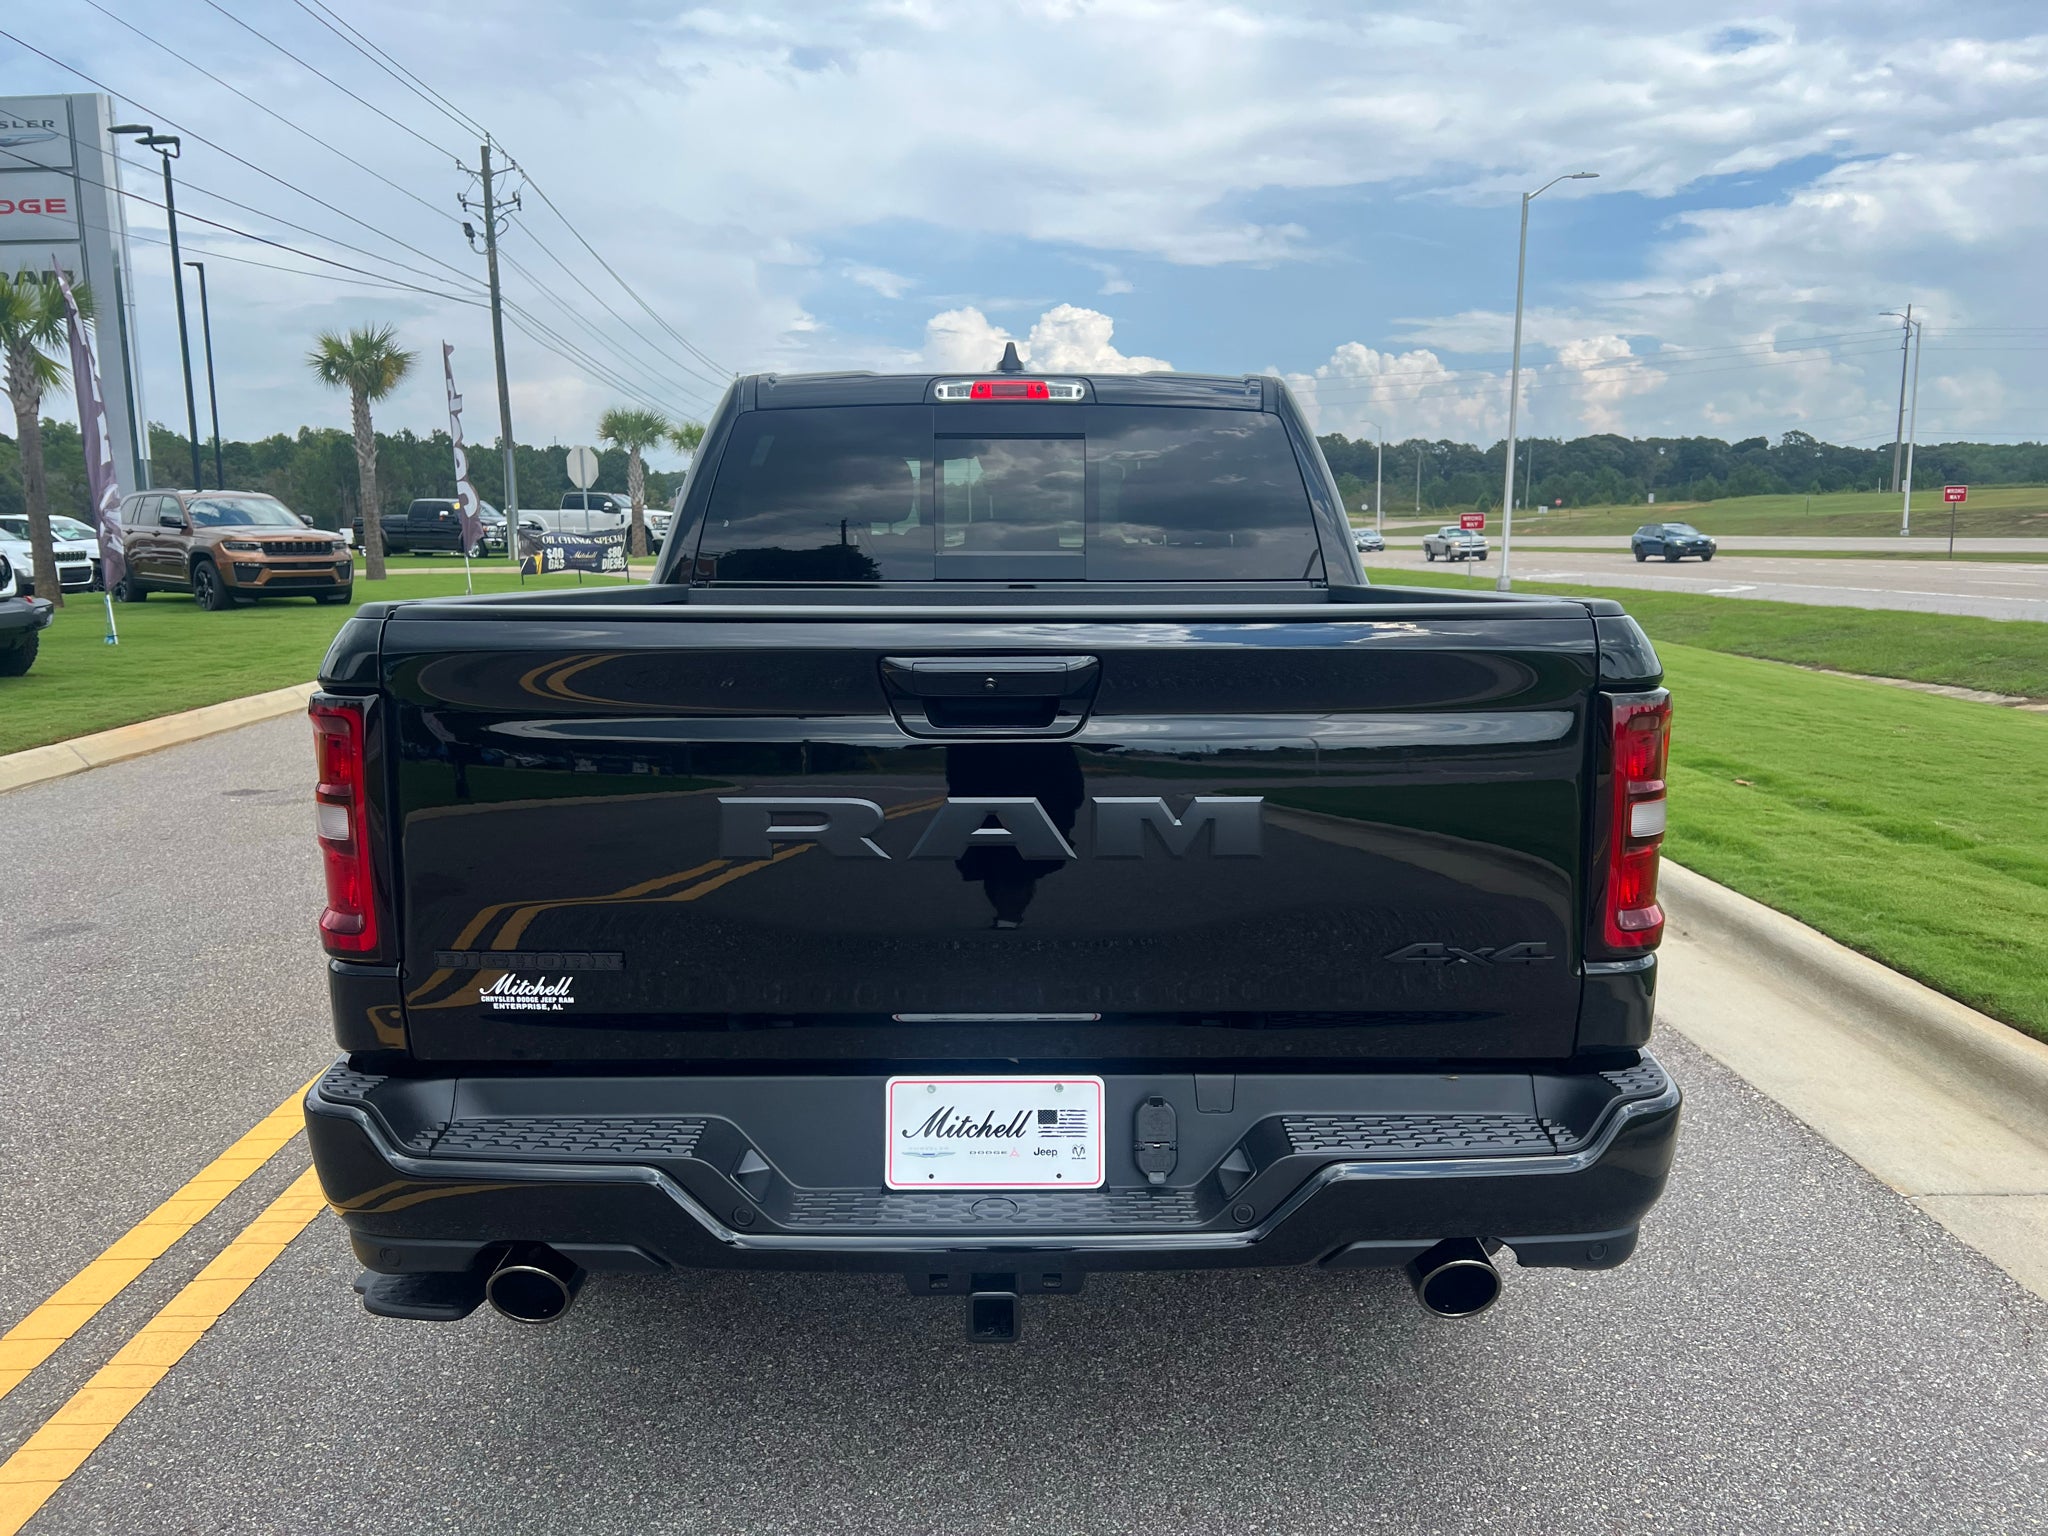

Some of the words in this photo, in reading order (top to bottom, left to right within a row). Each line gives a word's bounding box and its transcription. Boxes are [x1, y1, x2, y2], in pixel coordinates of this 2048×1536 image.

[542, 535, 558, 544] OIL
[558, 536, 592, 545] CHANGE
[594, 534, 624, 544] SPECIAL
[546, 547, 564, 559] $40
[570, 550, 598, 559] Mitchell
[548, 559, 566, 570] GAS
[602, 557, 626, 570] DIESEL
[717, 796, 1266, 860] RAM
[479, 973, 574, 996] Mitchell
[493, 1003, 551, 1011] ENTERPRISE,
[902, 1105, 1033, 1139] Mitchell
[1033, 1147, 1058, 1157] Jeep
